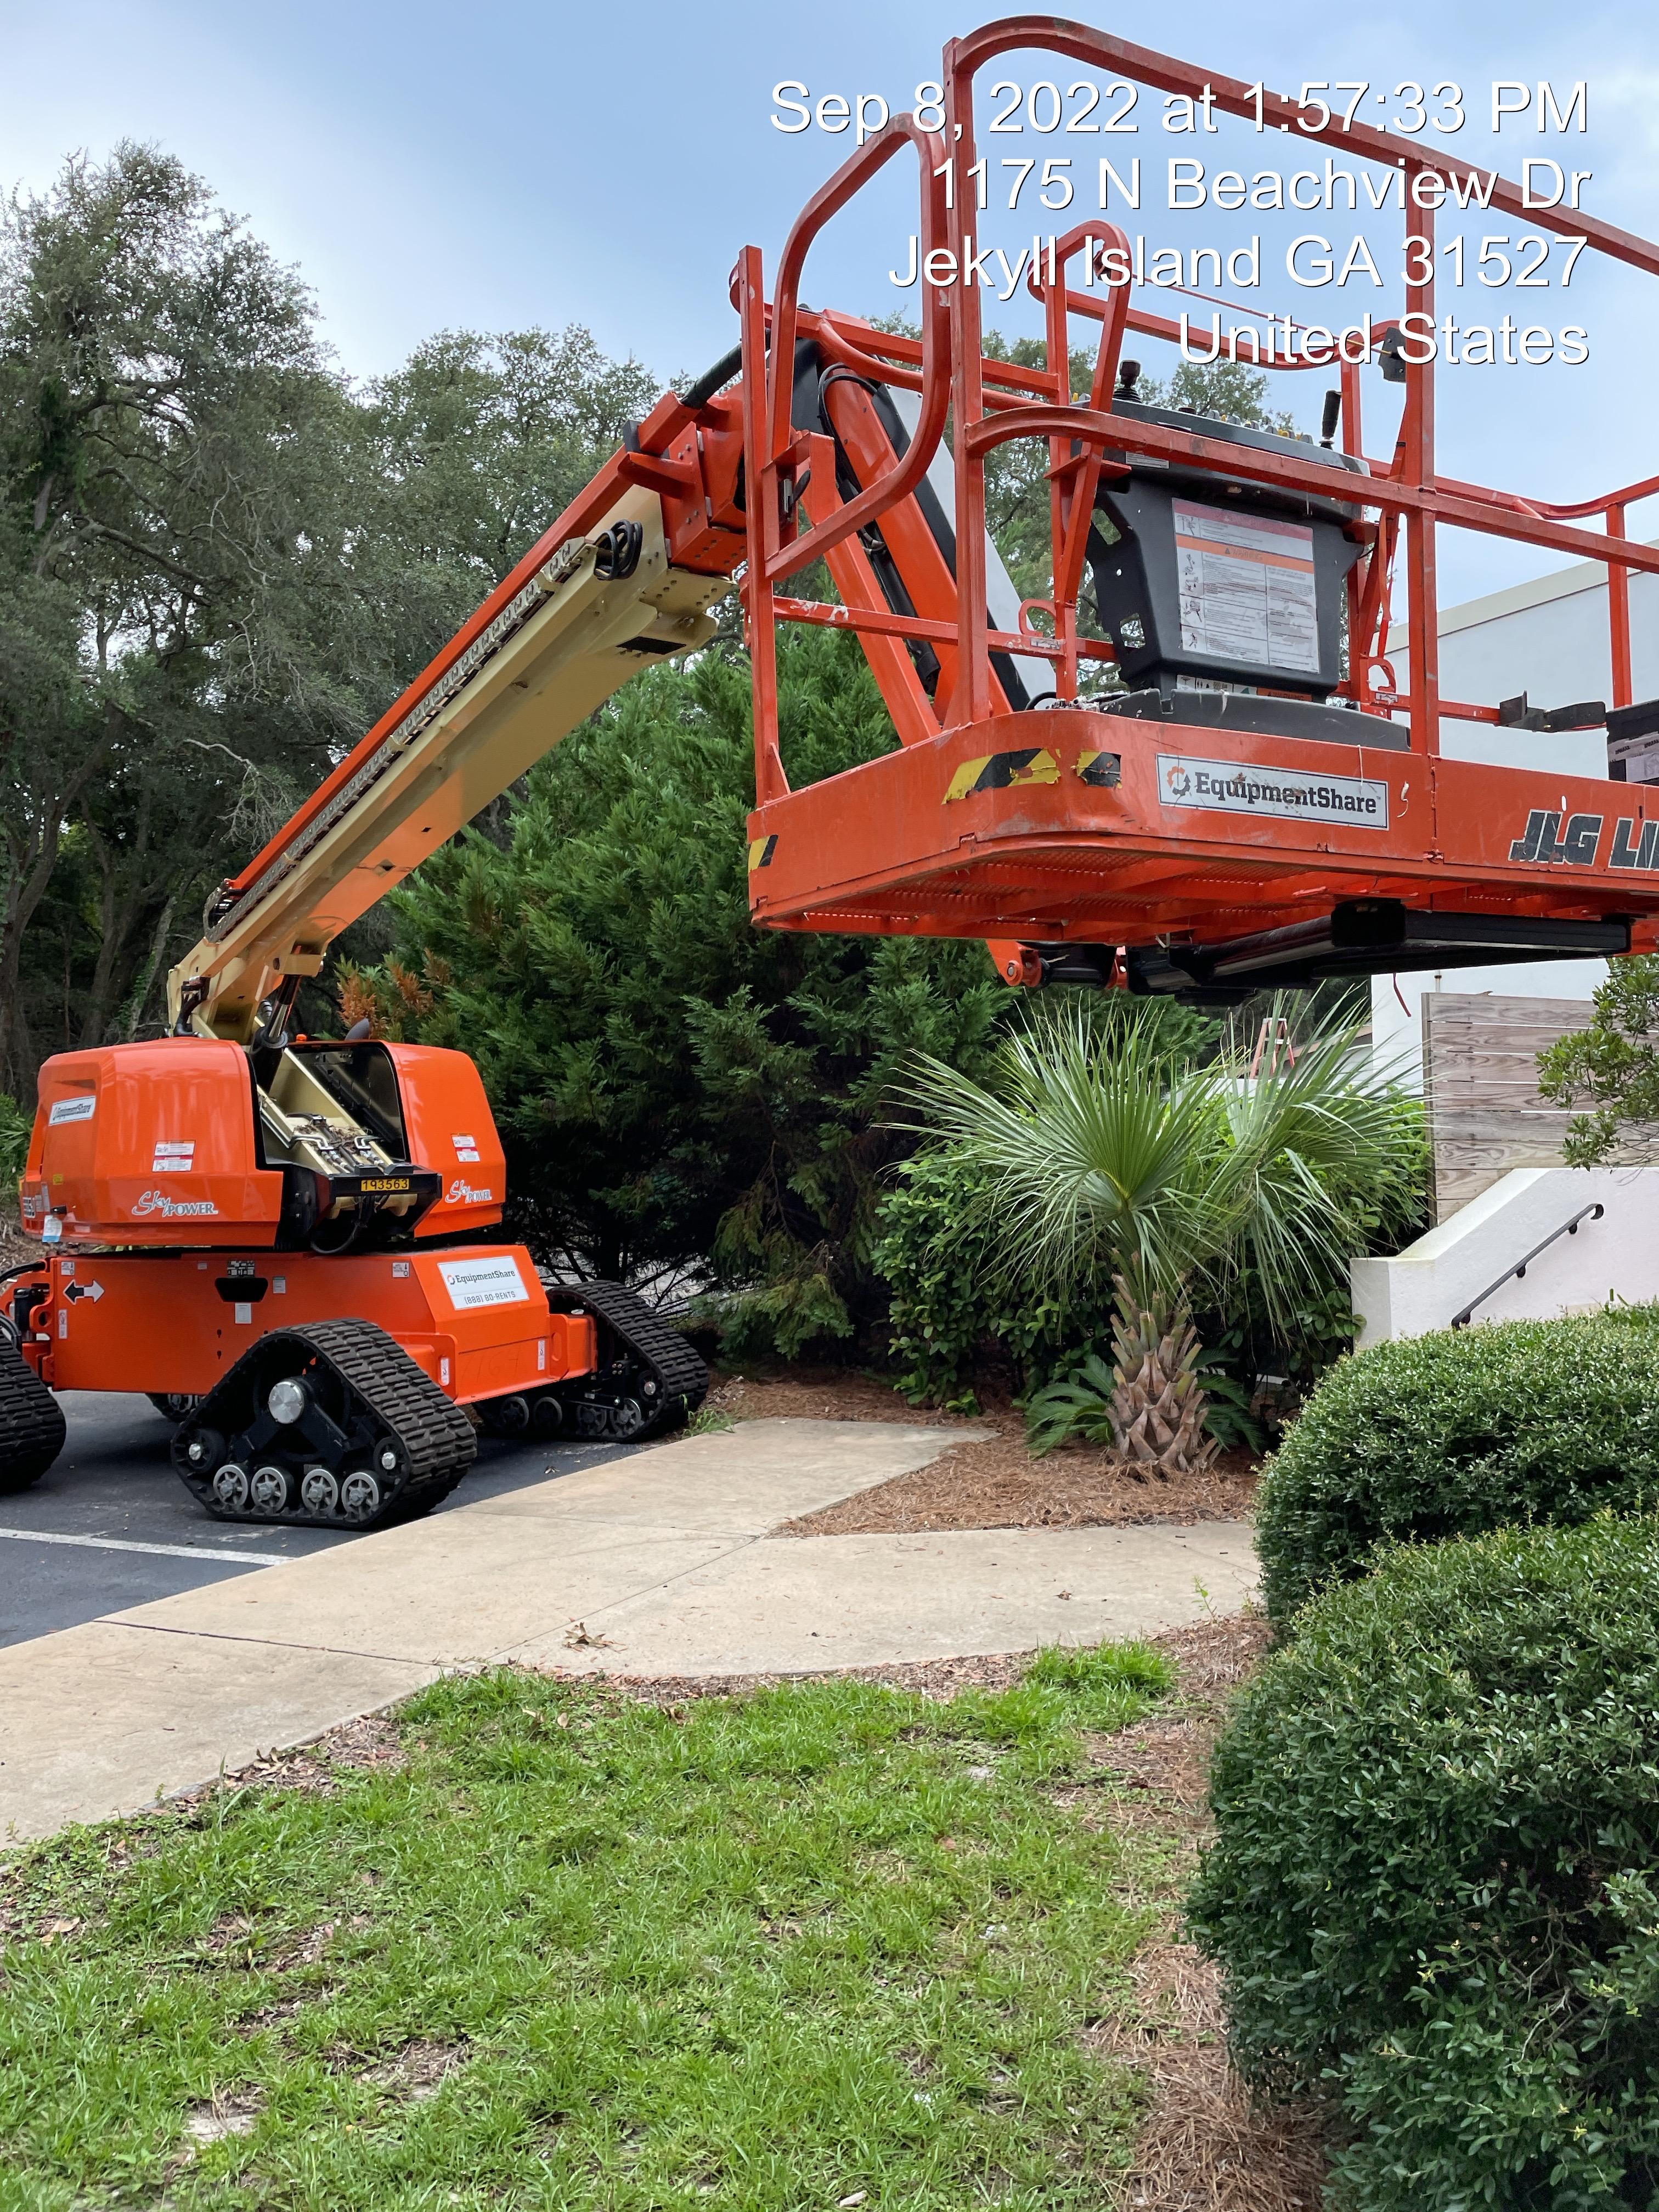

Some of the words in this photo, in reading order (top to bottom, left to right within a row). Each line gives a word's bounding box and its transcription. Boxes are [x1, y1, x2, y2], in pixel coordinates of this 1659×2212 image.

[1195, 771, 1377, 814] EquipmentShare
[1508, 809, 1604, 867] JLG
[1608, 817, 1659, 871] LI
[362, 1180, 408, 1190] 193563
[455, 1270, 516, 1284] EquipmentShare
[464, 1295, 483, 1305] (888)
[485, 1291, 516, 1301] 80-RENTS
